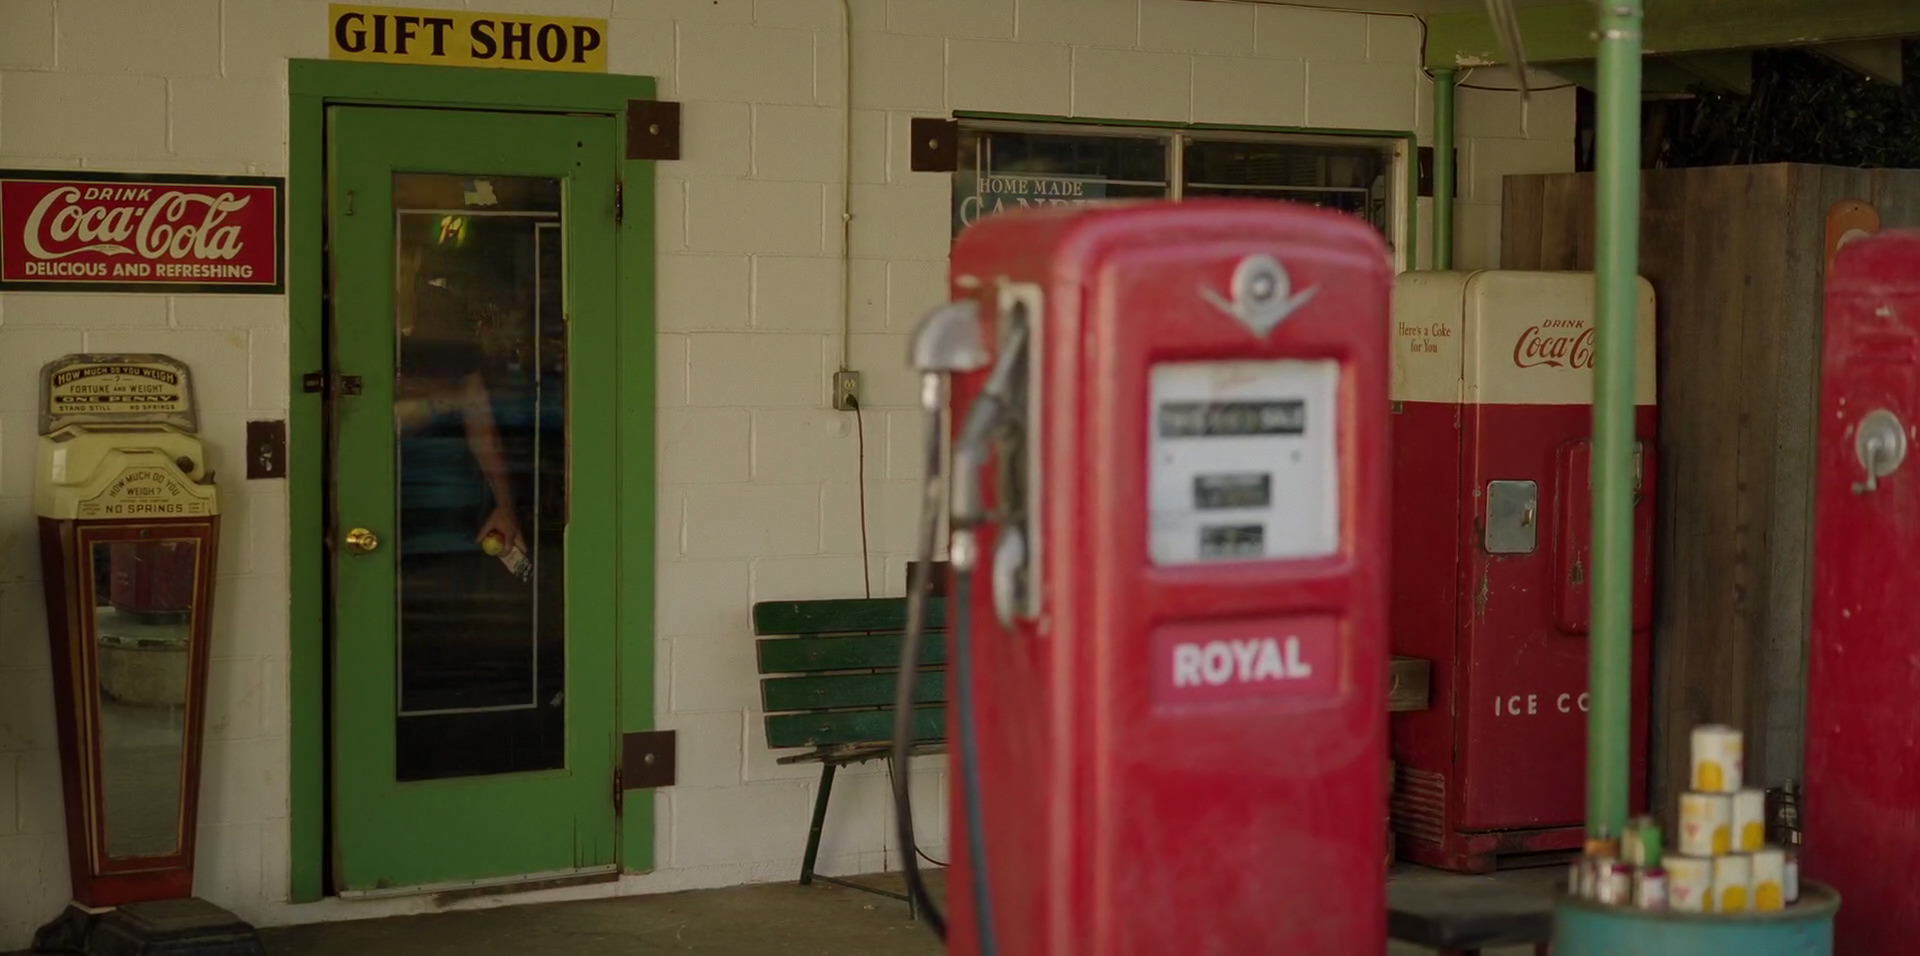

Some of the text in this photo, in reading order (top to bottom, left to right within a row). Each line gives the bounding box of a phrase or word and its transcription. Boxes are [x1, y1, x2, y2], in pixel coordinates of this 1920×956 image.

[335, 12, 601, 63] GIFT SHOP
[84, 187, 152, 201] DRINK
[980, 177, 1083, 196] HOME MADE
[23, 186, 251, 260] Coca-Cola
[25, 261, 254, 279] DELICIOUS AND REFRESHING
[1431, 322, 1452, 337] Coke
[1542, 319, 1585, 328] DRINK
[1410, 338, 1439, 353] for You
[57, 370, 81, 386] HOW
[83, 367, 108, 378] MUCH
[122, 366, 141, 376] YOU
[142, 367, 175, 385] WEIGH
[70, 384, 110, 394] FORTUNE
[130, 383, 163, 394] WEIGHT
[61, 395, 171, 403] ONE PENNY
[59, 404, 86, 412] STAND
[89, 404, 112, 412] STILL
[142, 403, 176, 411] SPRINGS
[108, 471, 181, 499] HOW MUCH DO YOU
[105, 504, 123, 514] NO
[127, 503, 184, 514] SPRINGS
[1172, 635, 1312, 689] ROYAL
[1494, 692, 1592, 717] ICE CO
